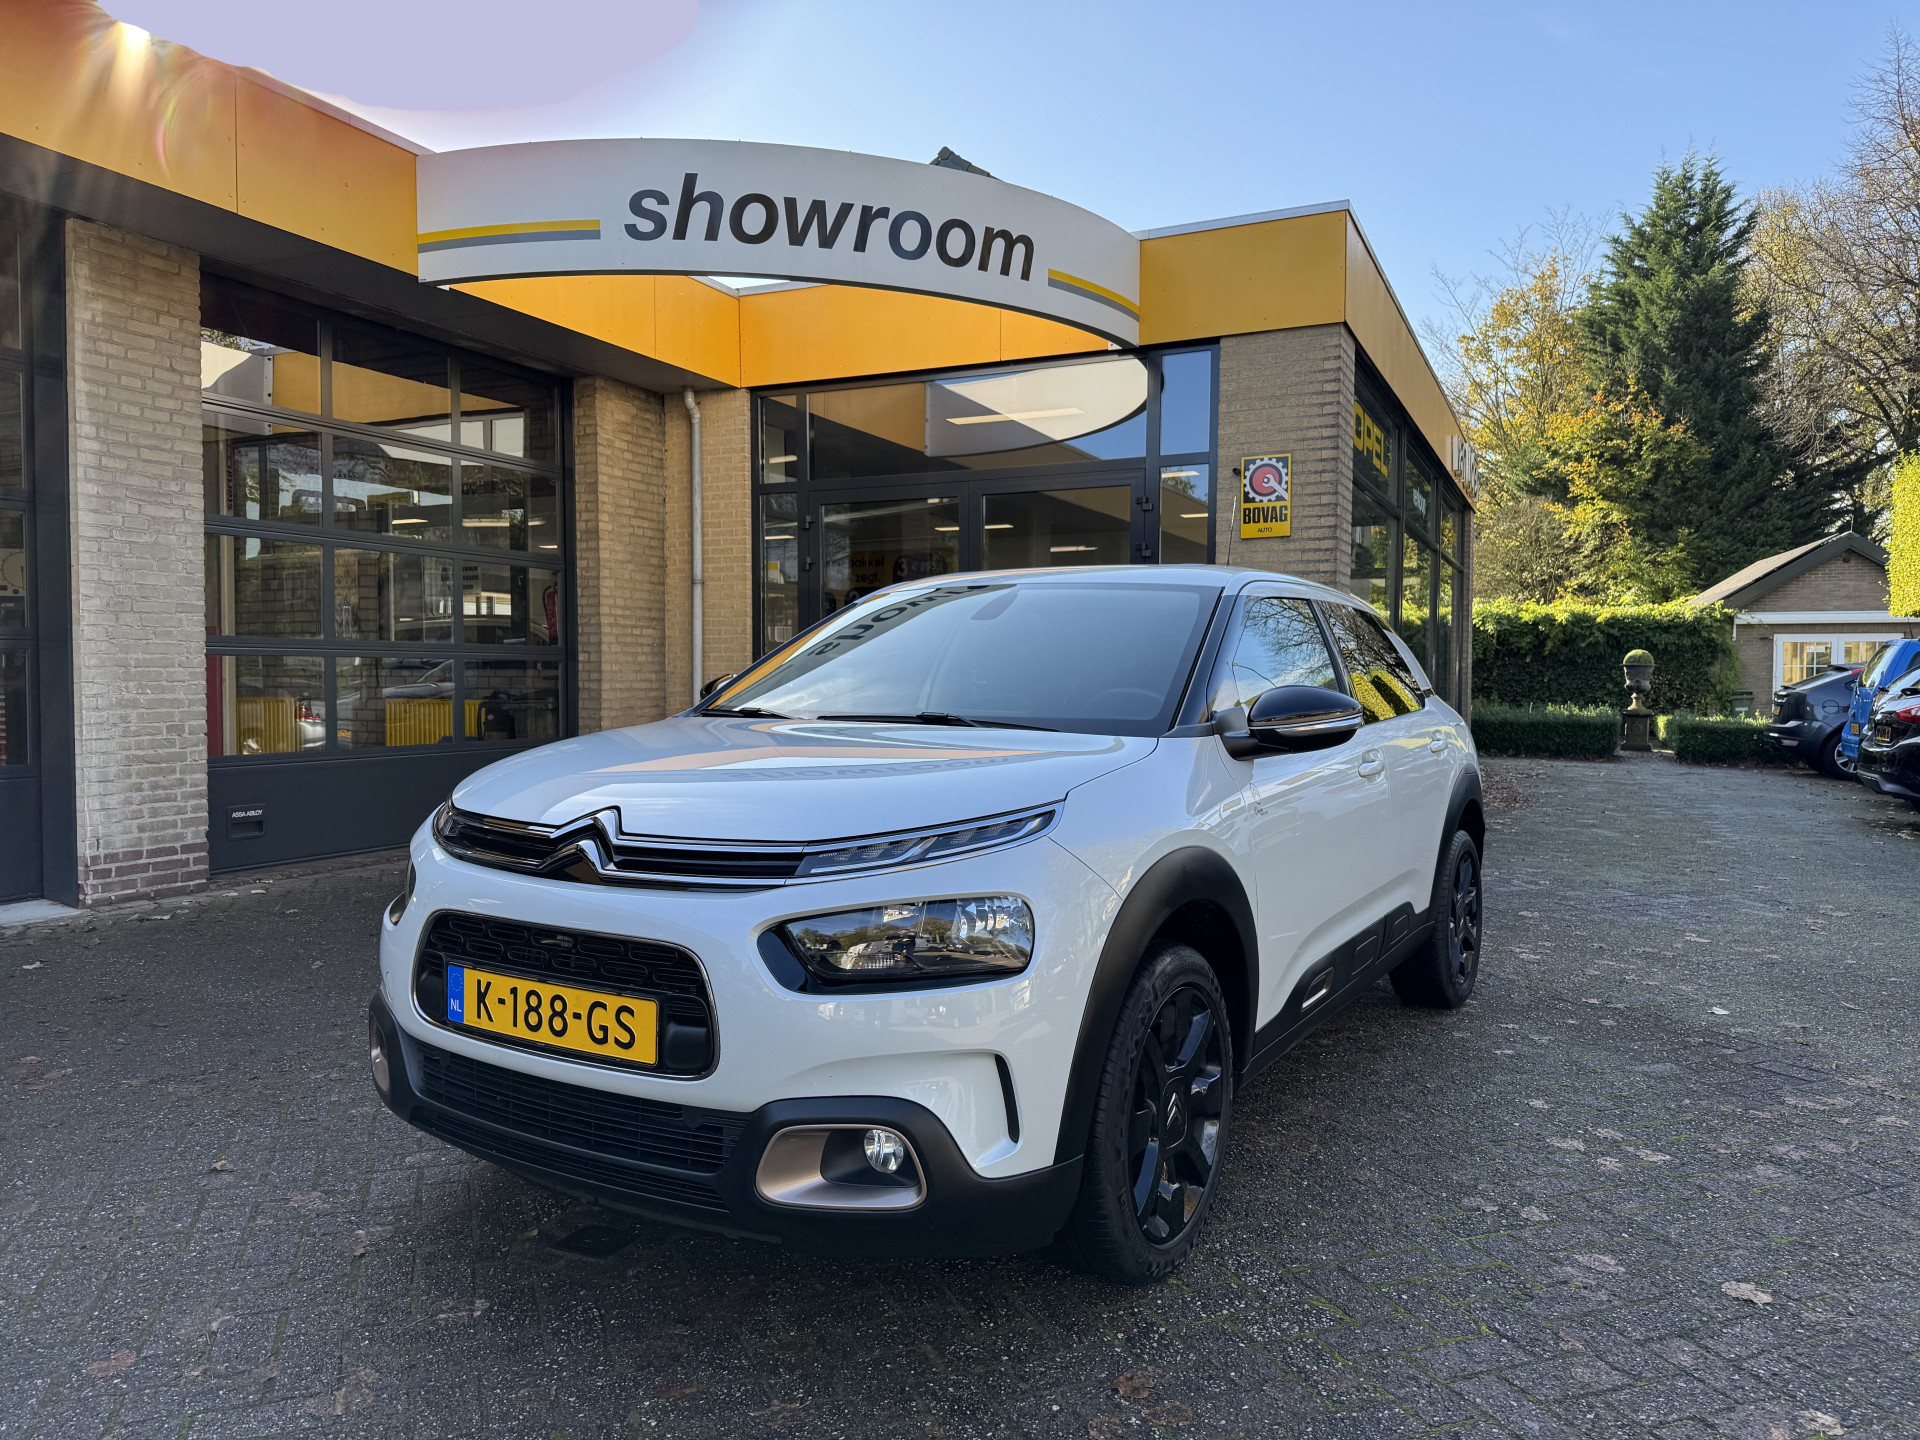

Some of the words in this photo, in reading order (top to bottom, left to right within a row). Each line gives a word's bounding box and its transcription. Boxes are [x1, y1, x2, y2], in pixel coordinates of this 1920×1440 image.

[623, 172, 1036, 282] showroom
[1353, 400, 1388, 478] OPEL
[1242, 505, 1288, 525] BOVAG
[450, 998, 462, 1013] NL
[476, 978, 636, 1050] K-188-GS
